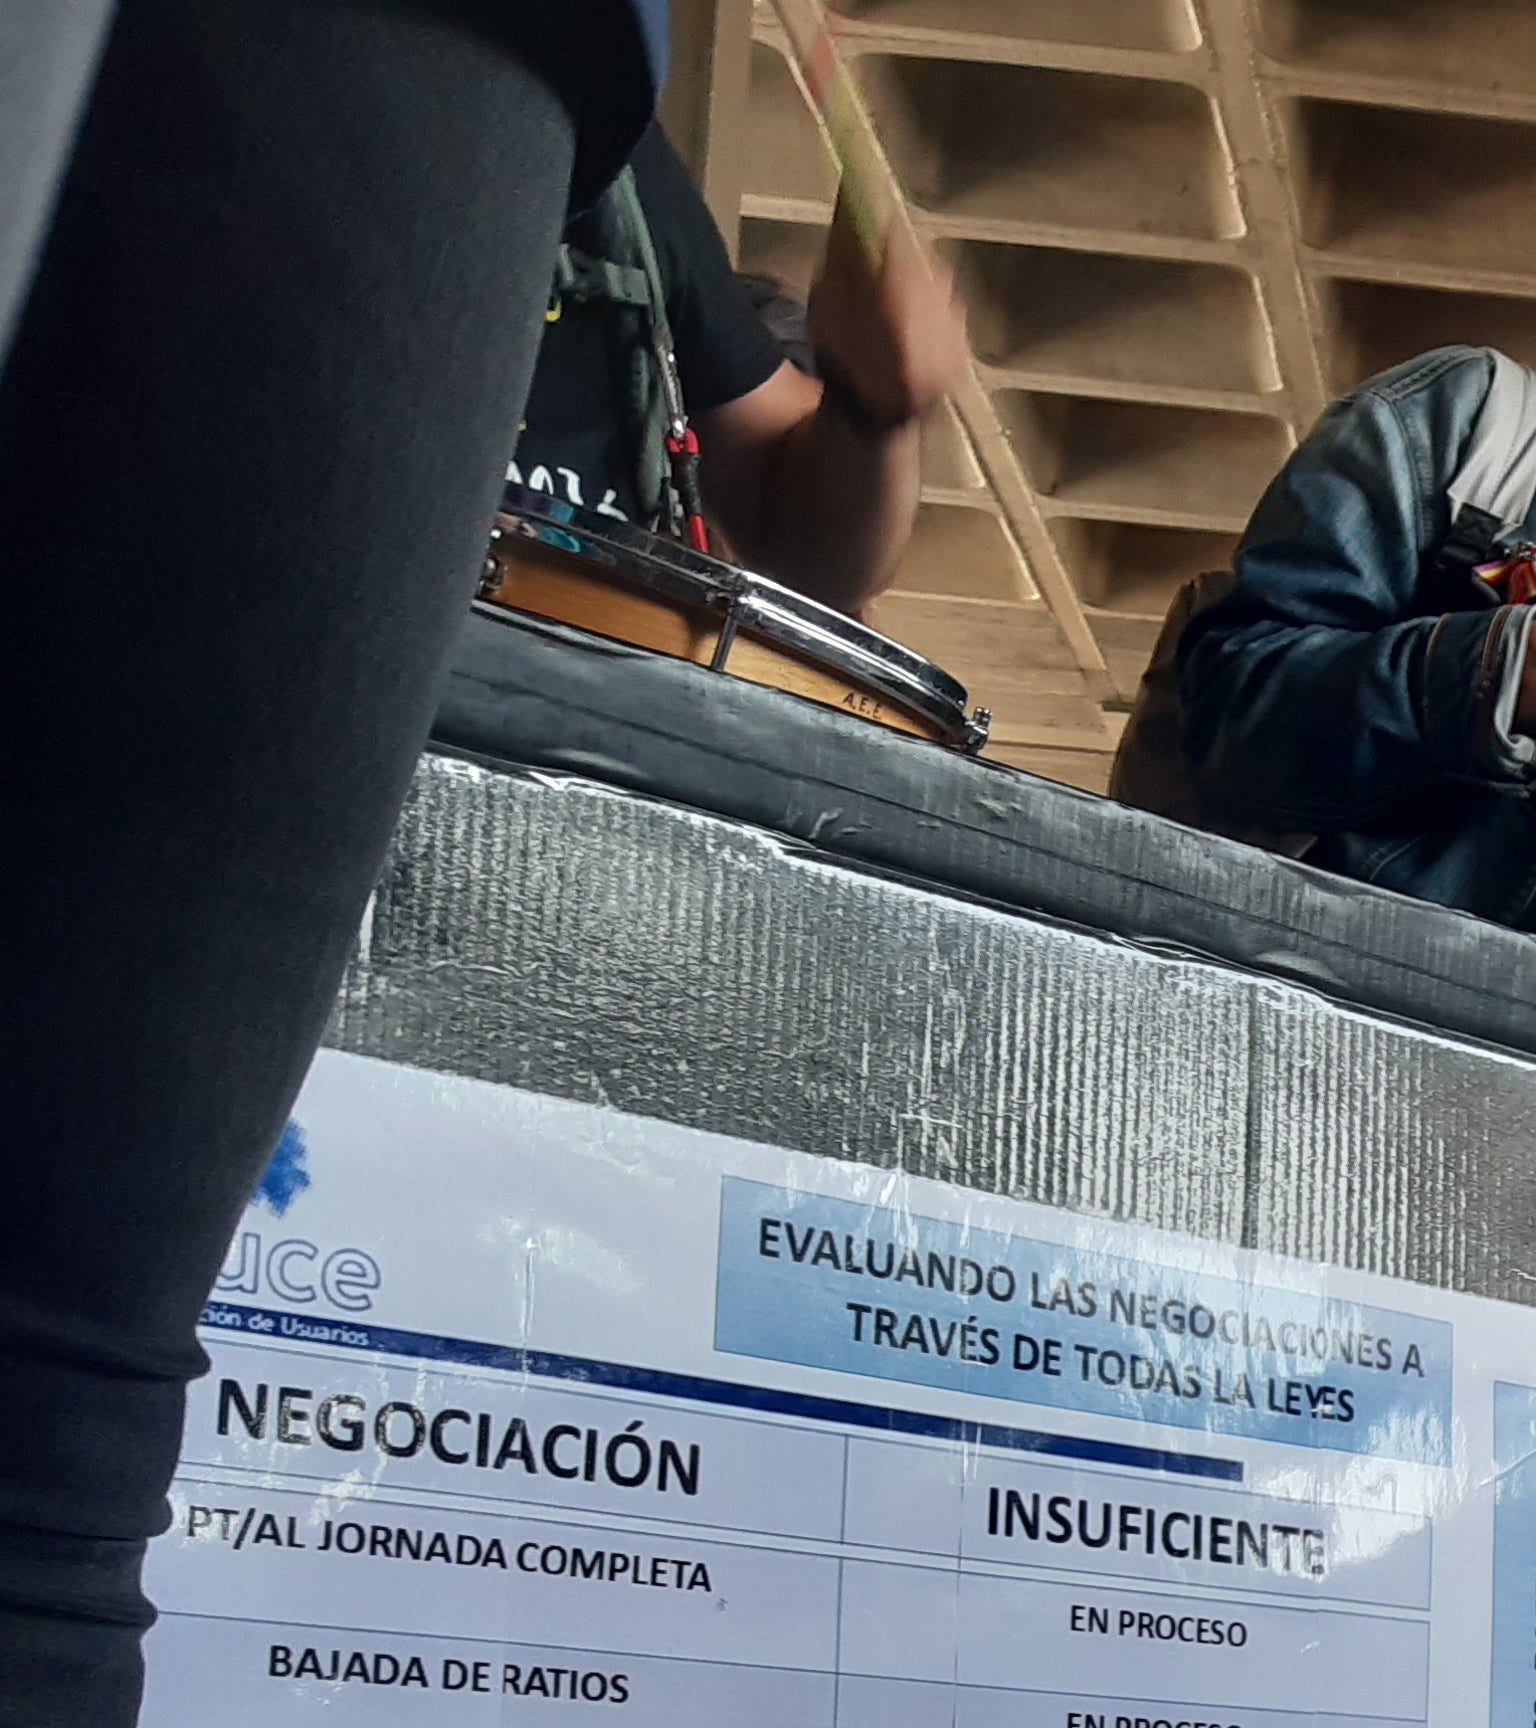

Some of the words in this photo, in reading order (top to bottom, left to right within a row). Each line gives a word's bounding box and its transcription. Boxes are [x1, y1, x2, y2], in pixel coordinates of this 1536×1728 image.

[214, 1231, 382, 1312] uce
[758, 1217, 1017, 1305] EVALUANDO
[1030, 1269, 1097, 1321] LAS
[1110, 1290, 1394, 1373] NEGOCIACIONES
[1401, 1345, 1426, 1380] A
[247, 1312, 275, 1333] de
[280, 1317, 370, 1346] Usuarios
[846, 1301, 1000, 1368] TRAVÉS
[1013, 1336, 1063, 1378] DE
[1075, 1346, 1202, 1401] TODAS
[1212, 1371, 1256, 1412] LA
[1266, 1379, 1355, 1425] LEYES
[216, 1379, 702, 1496] NEGOCIACIÓN
[188, 1504, 306, 1553] PT/AL
[316, 1524, 508, 1571] JORNADA
[517, 1542, 713, 1594] COMPLETA
[986, 1486, 1327, 1577] INSUFICIENTE
[1069, 1604, 1112, 1636] EN
[1118, 1608, 1249, 1648] PROCESO
[269, 1644, 429, 1690] BAJADA
[441, 1660, 491, 1693] DE
[501, 1665, 629, 1704] RATIOS
